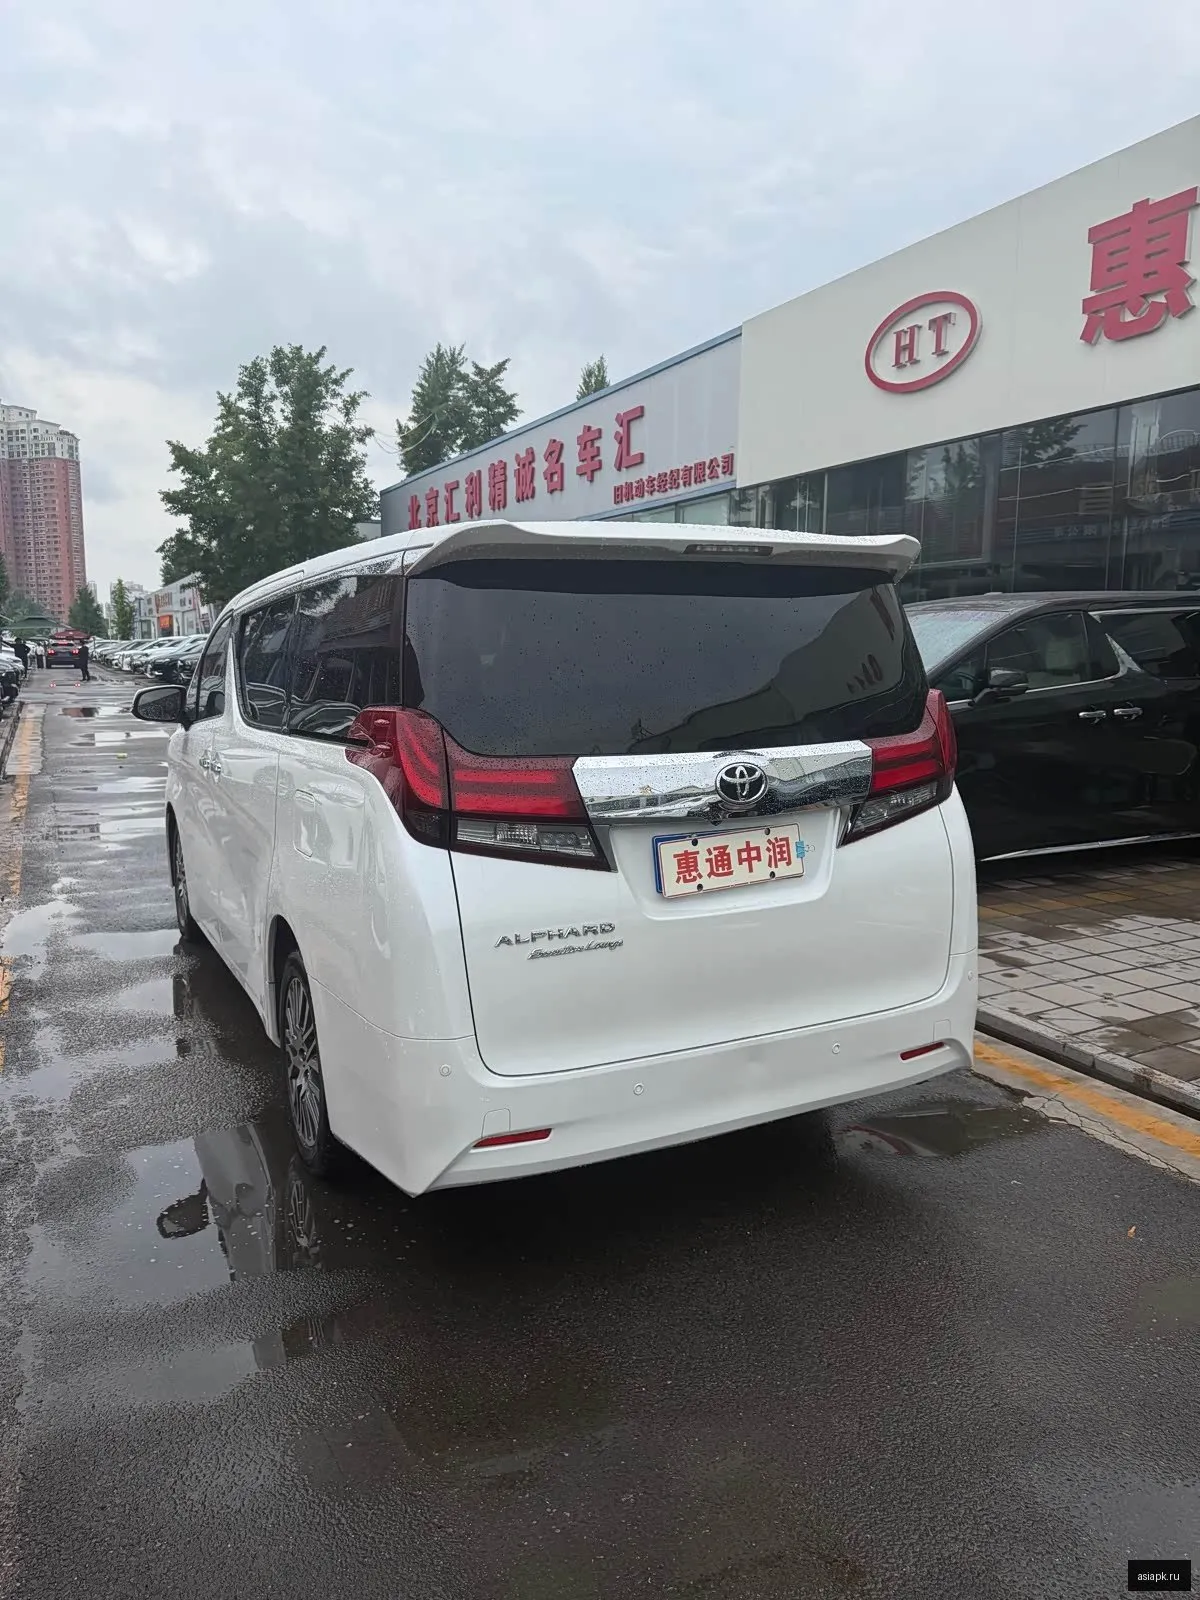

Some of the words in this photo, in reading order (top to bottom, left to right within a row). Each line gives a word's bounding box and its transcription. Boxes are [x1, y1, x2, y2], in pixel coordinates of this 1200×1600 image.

[1079, 185, 1200, 346] 惠
[892, 312, 957, 369] HT
[408, 405, 645, 530] 北京汇利精诚名车汇
[673, 836, 792, 884] 惠通中润
[494, 922, 616, 948] ALPHARD
